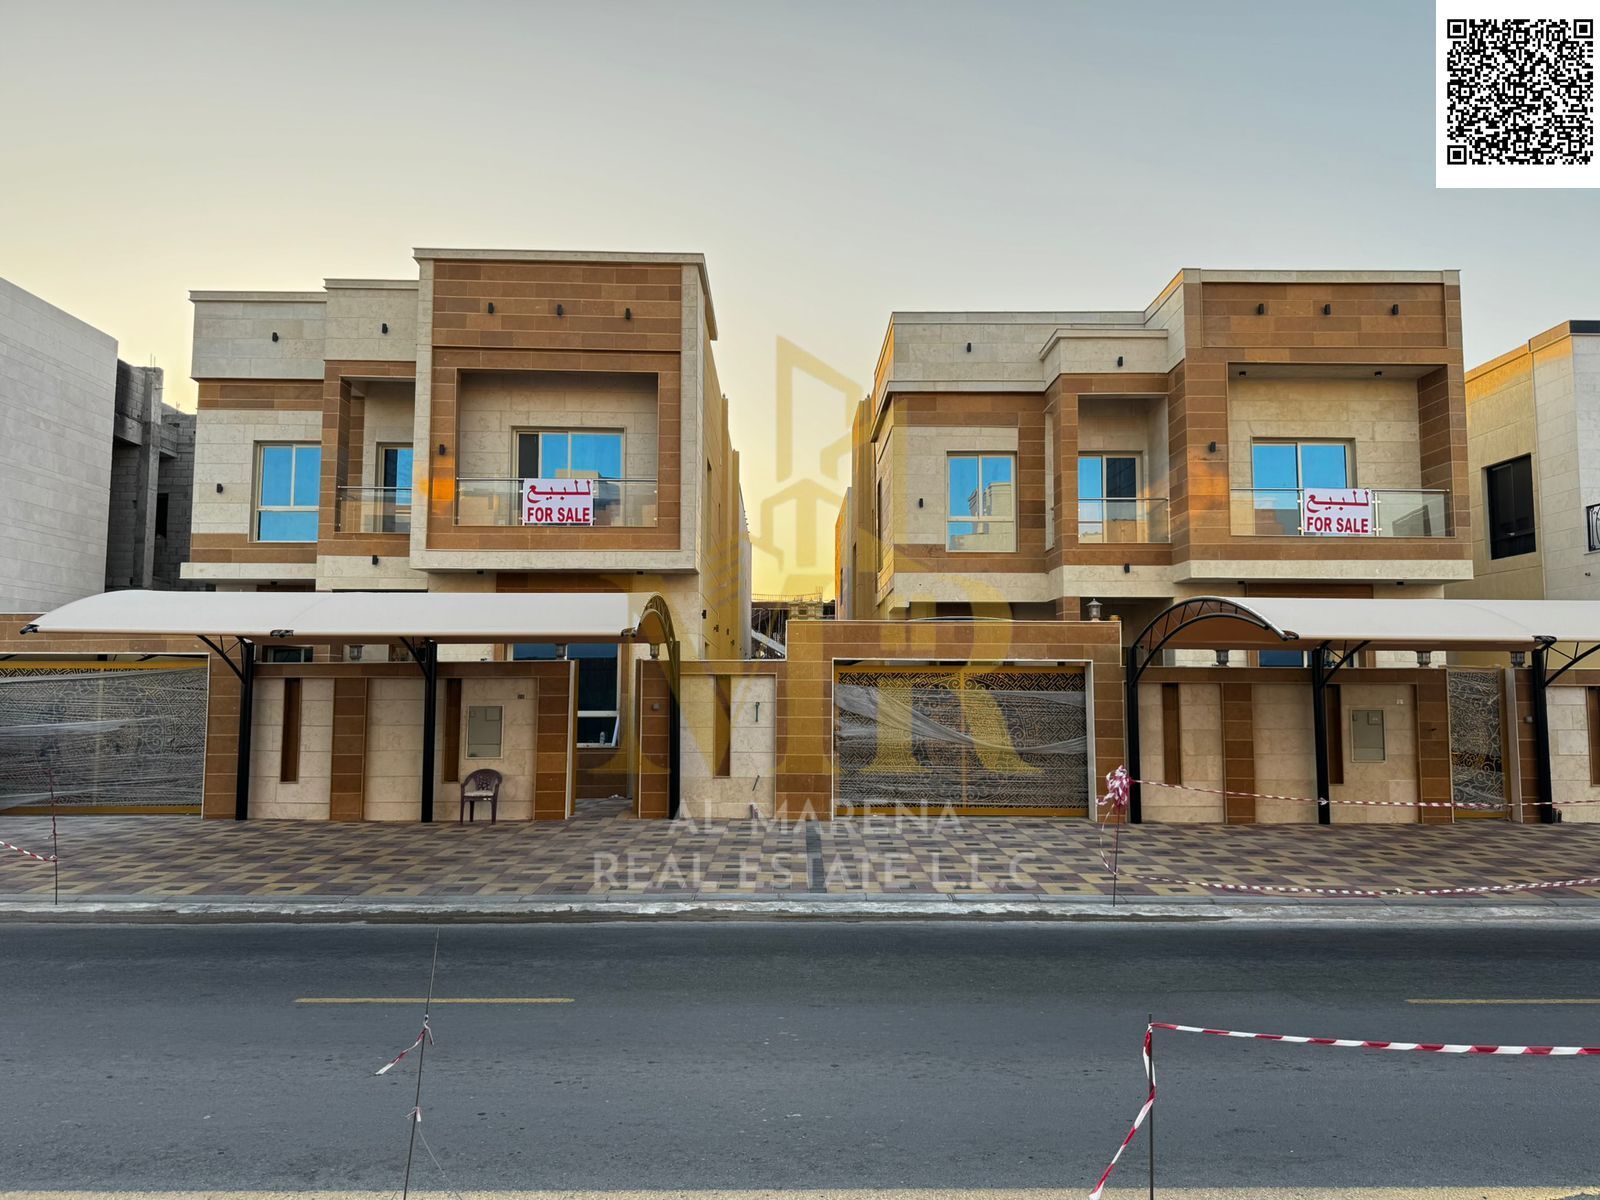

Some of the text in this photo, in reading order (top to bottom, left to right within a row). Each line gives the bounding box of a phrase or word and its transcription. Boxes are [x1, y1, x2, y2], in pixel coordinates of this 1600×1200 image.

[527, 480, 591, 504] للبيع
[1306, 490, 1369, 513] للبيع
[527, 507, 590, 522] FOR SALE
[1307, 516, 1369, 533] FOR SALE
